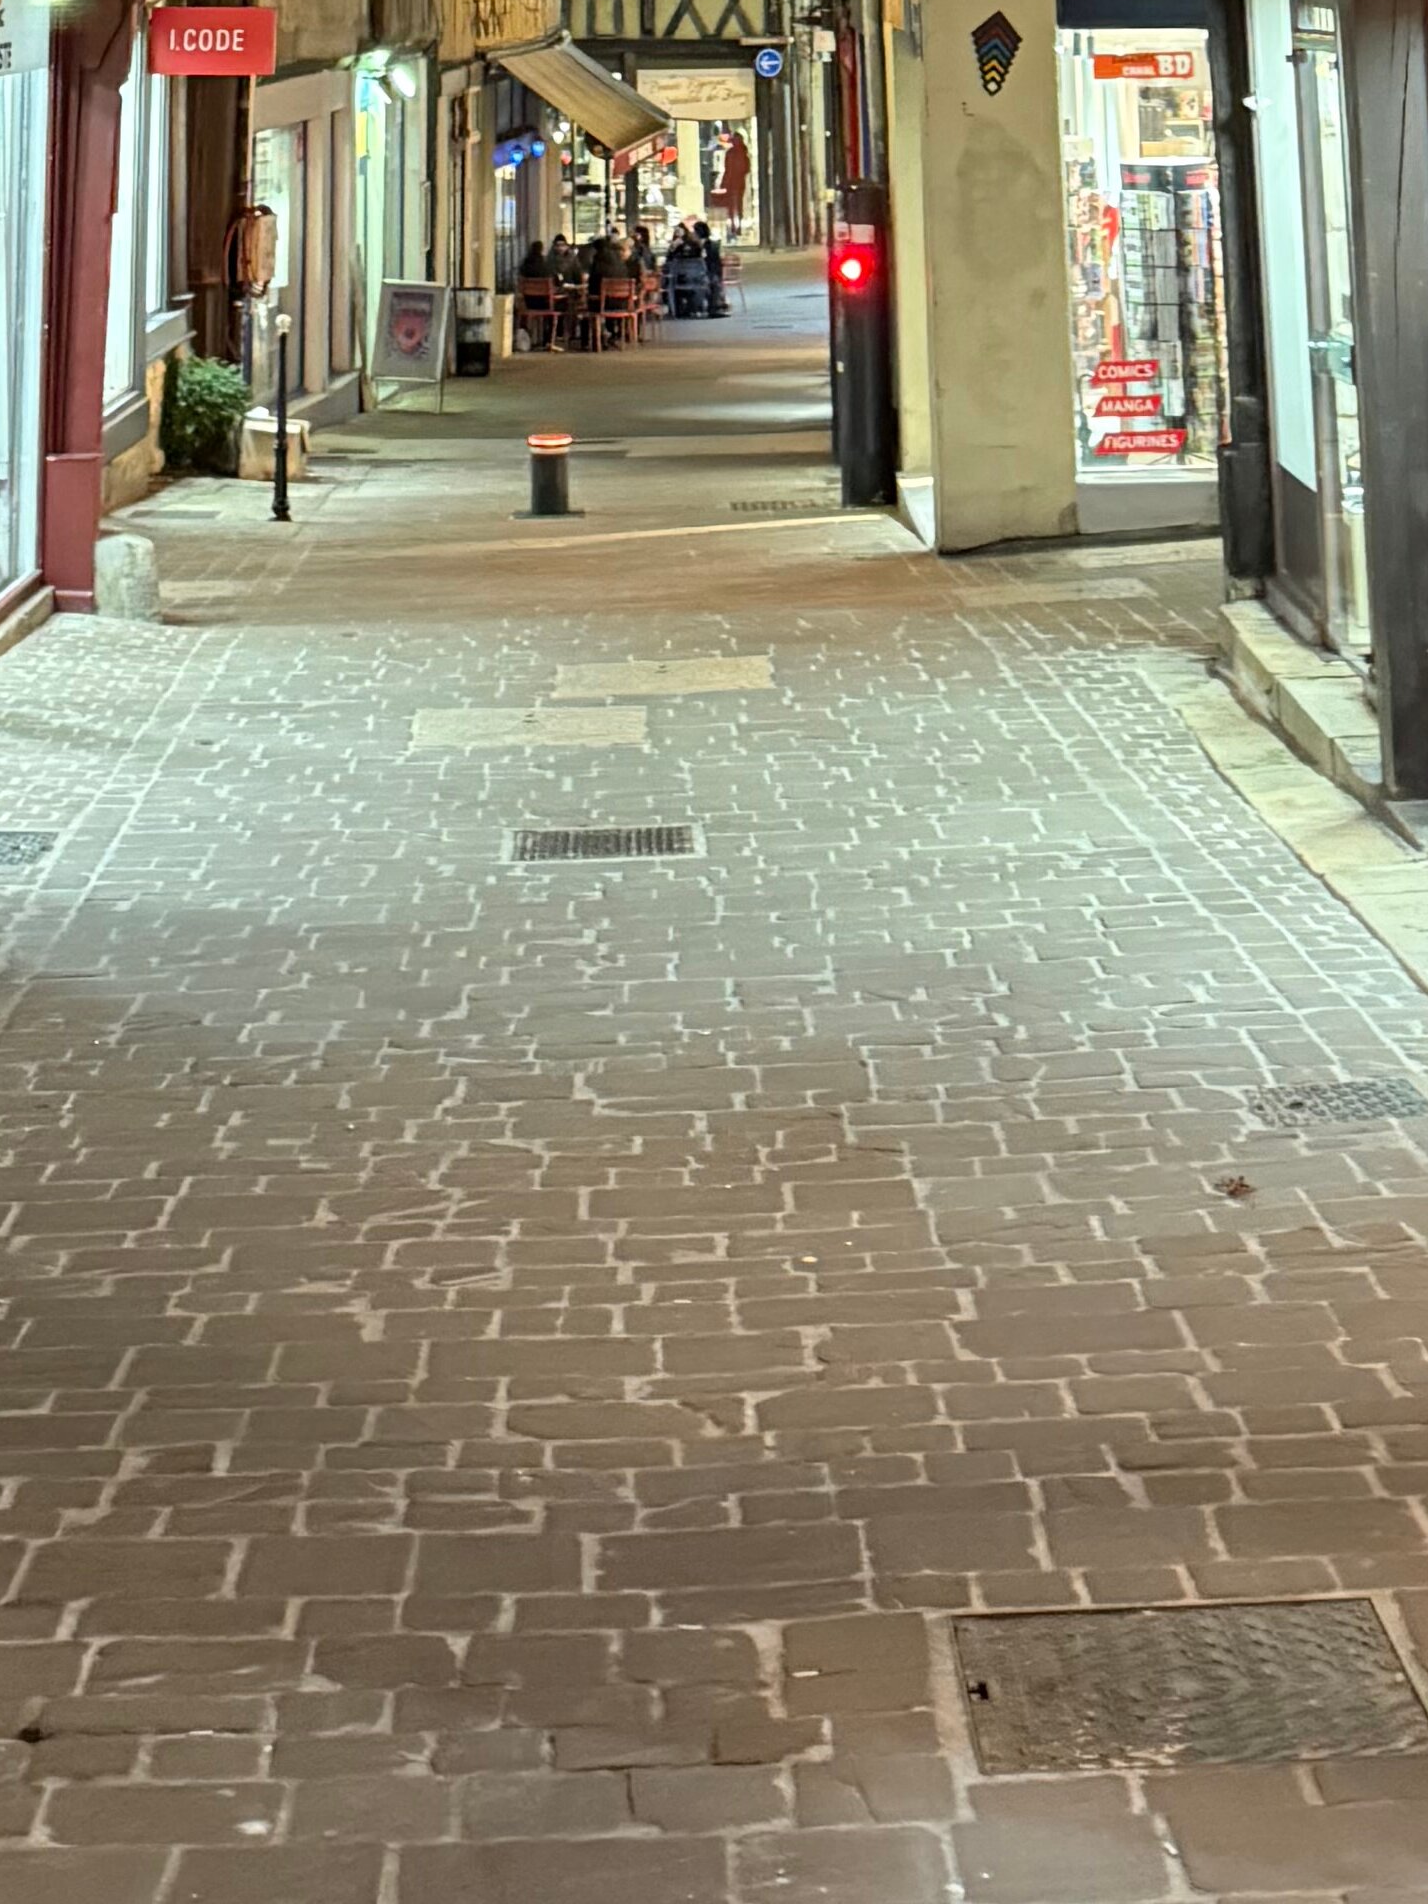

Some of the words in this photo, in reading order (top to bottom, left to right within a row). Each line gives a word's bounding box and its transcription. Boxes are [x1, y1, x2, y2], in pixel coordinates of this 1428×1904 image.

[169, 28, 245, 52] I.CODE
[1155, 54, 1191, 76] BD
[1097, 363, 1154, 379] COMICS
[1101, 398, 1154, 412] MANGA
[1102, 433, 1180, 449] FIGURINES
